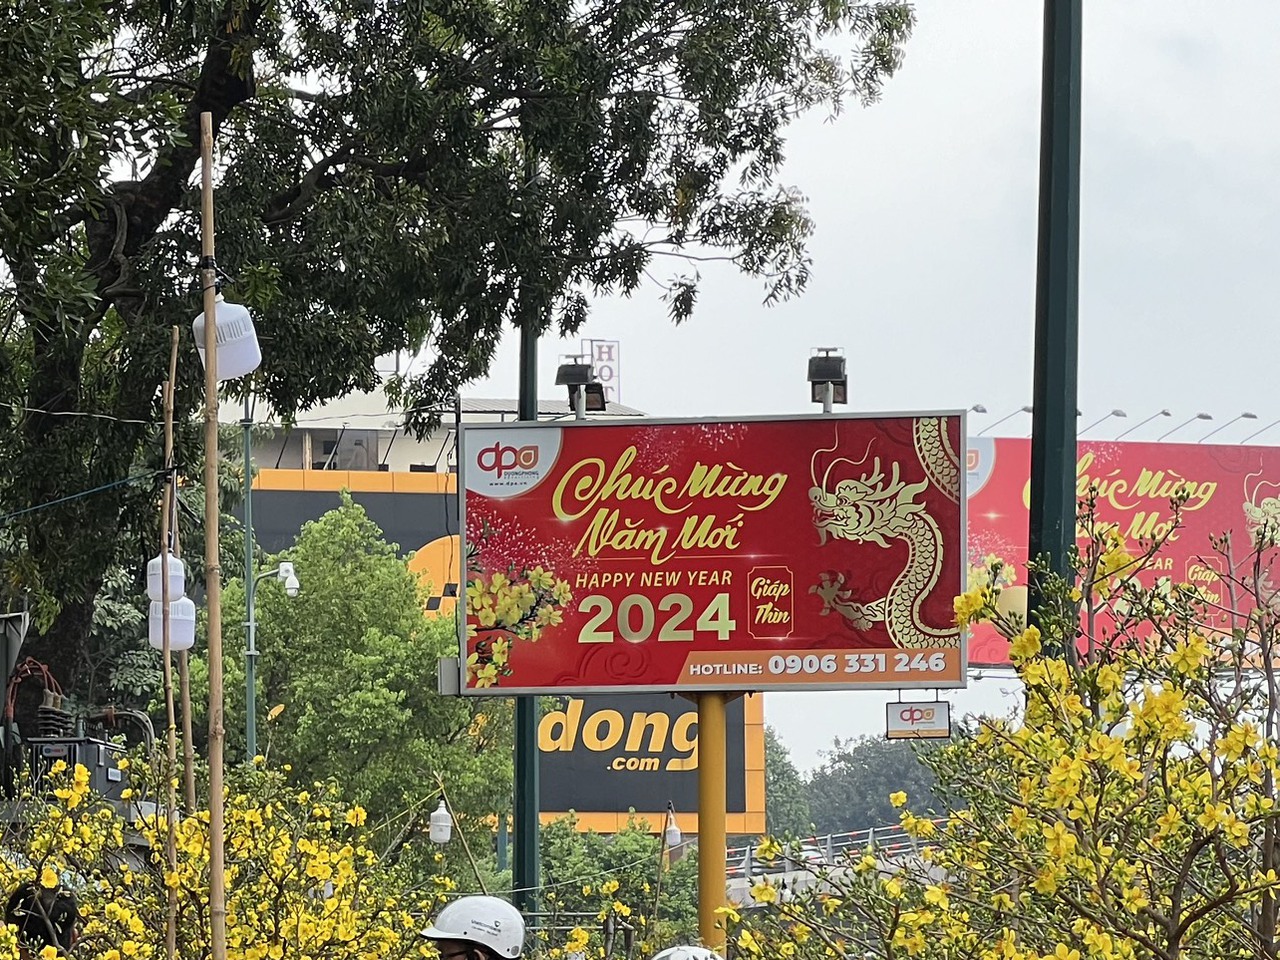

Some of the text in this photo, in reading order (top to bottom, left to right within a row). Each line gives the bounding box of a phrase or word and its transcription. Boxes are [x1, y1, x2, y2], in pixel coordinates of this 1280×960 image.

[477, 441, 539, 479] dpa
[552, 445, 789, 521] Chúc Mừng
[572, 507, 745, 565] Năm Mới
[575, 570, 734, 589] HAPPY NEW YEAR
[750, 577, 791, 602] Giáp
[577, 592, 737, 644] 2024
[754, 601, 791, 625] Thìn
[689, 652, 947, 676] HOTLINE: 0906 331 246
[606, 757, 661, 772] .com
